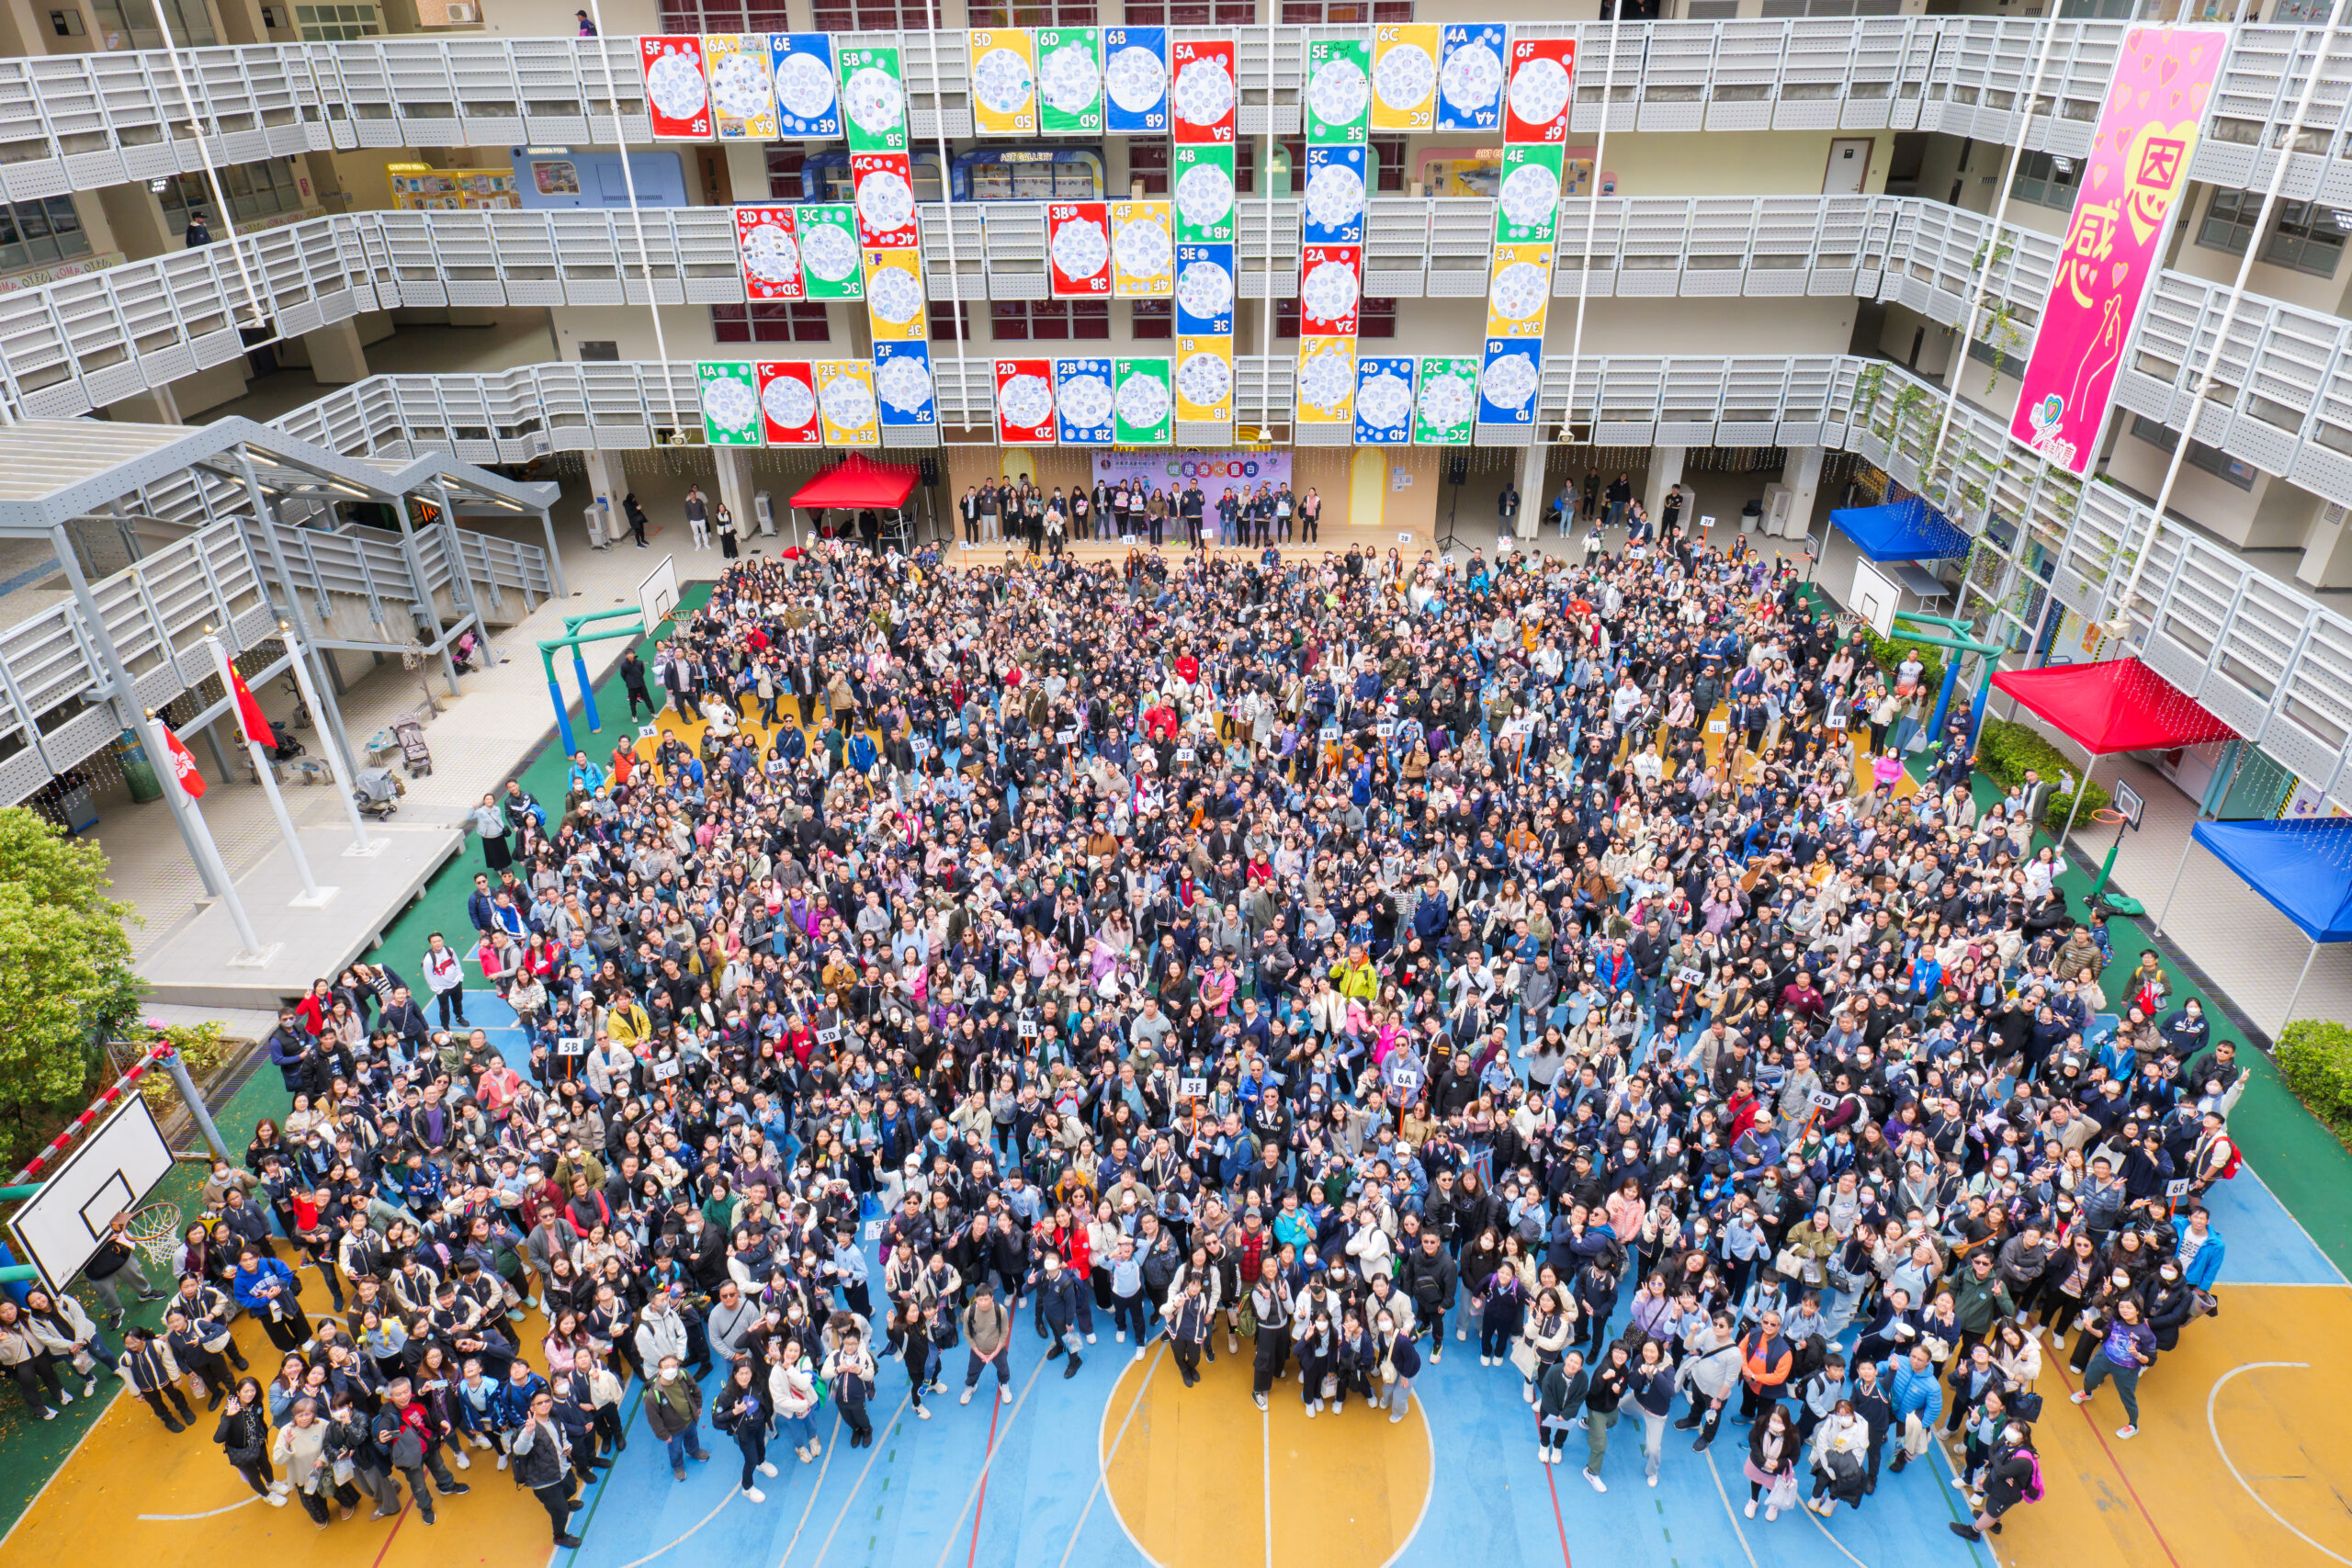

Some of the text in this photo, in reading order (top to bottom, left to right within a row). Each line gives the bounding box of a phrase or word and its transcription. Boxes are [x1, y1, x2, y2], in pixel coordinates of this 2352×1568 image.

[974, 32, 991, 46] 5D
[1040, 32, 1059, 45] 6D
[1108, 30, 1126, 45] 6B
[1379, 28, 1398, 41] 6C
[1447, 28, 1467, 42] 4A
[645, 40, 661, 54] 5F
[707, 39, 728, 52] 6A
[774, 38, 790, 51] 6E
[1516, 43, 1534, 57] 6F
[1176, 45, 1194, 59] 5A
[1311, 45, 1329, 59] 5E
[842, 53, 859, 66] 5B
[1014, 115, 1032, 128] 5D
[1080, 114, 1099, 127] 6D
[1146, 114, 1164, 127] 6B
[1410, 111, 1430, 125] 6C
[1475, 111, 1495, 125] 4A
[692, 119, 707, 132] 5F
[754, 119, 775, 133] 6A
[820, 118, 835, 132] 6E
[1212, 127, 1231, 140] 5A
[1347, 127, 1363, 140] 5E
[1544, 126, 1562, 140] 6F
[887, 133, 902, 146] 5B
[1001, 152, 1053, 162] ART GALLERY
[1178, 150, 1195, 163] 4B
[1309, 151, 1328, 164] 5C
[1507, 150, 1524, 163] 4E
[854, 157, 872, 170] 4C
[740, 211, 757, 223] 3D
[802, 209, 819, 221] 3C
[1052, 208, 1069, 220] 3B
[1116, 205, 1132, 218] 4F
[897, 232, 915, 244] 4C
[1214, 227, 1231, 239] 4B
[1341, 227, 1359, 240] 5C
[1534, 226, 1552, 239] 4E
[867, 254, 882, 265] 3F
[1180, 248, 1195, 260] 3E
[1306, 249, 1326, 261] 2A
[1497, 248, 1516, 261] 3A
[782, 284, 799, 295] 3D
[842, 282, 859, 294] 3C
[1090, 278, 1106, 289] 3B
[1153, 279, 1170, 291] 4F
[908, 325, 922, 336] 3F
[1214, 320, 1229, 332] 3E
[1335, 321, 1354, 332] 2A
[1522, 321, 1541, 333] 3A
[876, 344, 892, 356] 2F
[1182, 339, 1194, 351] 1B
[1304, 341, 1317, 352] 1E
[1488, 342, 1503, 353] 1D
[701, 365, 717, 376] 1A
[760, 365, 775, 376] 1C
[820, 365, 836, 376] 2E
[999, 364, 1015, 374] 2D
[1060, 363, 1077, 374] 2B
[1118, 363, 1131, 374] 1F
[1360, 362, 1378, 373] 4D
[1424, 362, 1442, 373] 2C
[916, 411, 932, 422] 2F
[1214, 408, 1227, 419] 1B
[1336, 409, 1349, 420] 1E
[1515, 409, 1530, 421] 1D
[741, 430, 756, 441] 1A
[803, 430, 817, 441] 1C
[859, 430, 875, 441] 2E
[1035, 427, 1052, 437] 2D
[1094, 429, 1111, 440] 2B
[1154, 429, 1166, 440] 1F
[1389, 429, 1407, 440] 4D
[1449, 429, 1467, 440] 2C
[1169, 463, 1254, 476] 健康身心靈日
[1182, 751, 1190, 760] 3F
[1684, 972, 1699, 982] 6C
[1023, 1025, 1033, 1033] 5E
[822, 1032, 836, 1042] 5D
[564, 1043, 578, 1052] 5B
[659, 1065, 675, 1077] 5C
[1397, 1074, 1411, 1084] 6A
[1188, 1083, 1201, 1092] 5F
[1814, 1095, 1830, 1105] 6D
[2172, 1182, 2184, 1193] 6F
